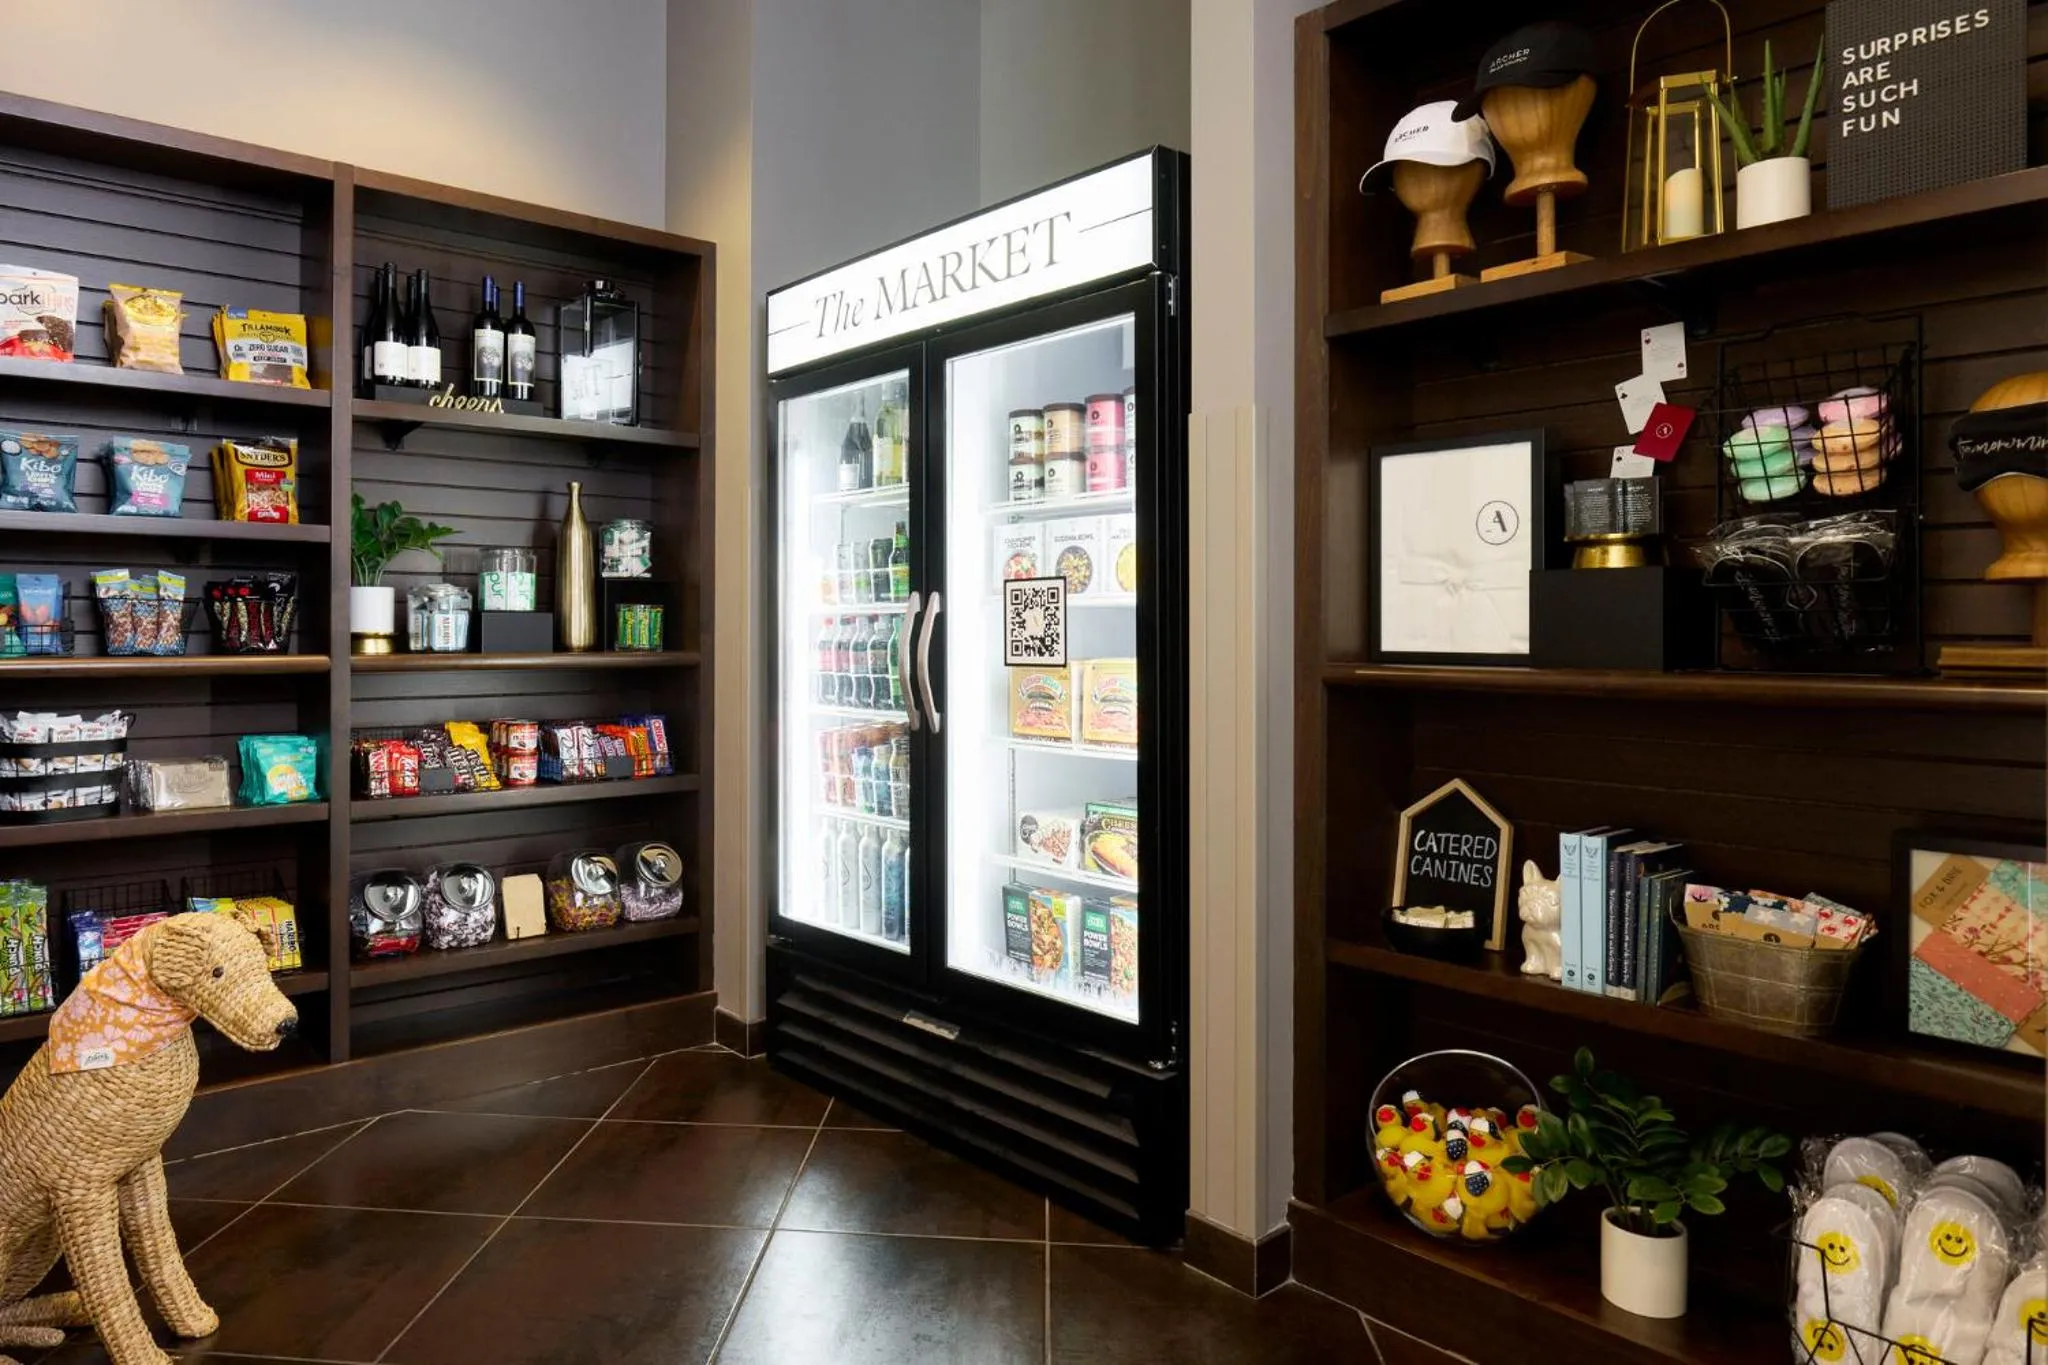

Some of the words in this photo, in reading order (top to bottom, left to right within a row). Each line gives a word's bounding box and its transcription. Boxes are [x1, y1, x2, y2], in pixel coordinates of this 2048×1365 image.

[1842, 8, 1990, 65] SURPRISES
[1489, 48, 1530, 68] ARCHER
[1842, 61, 1891, 90] ARE
[1842, 78, 1918, 113] SUCH
[1842, 107, 1901, 138] FUN
[813, 290, 865, 340] The
[873, 211, 1072, 321] MARKET
[20, 456, 62, 474] Kibo
[239, 450, 287, 462] SNYDER'S
[130, 464, 170, 484] Kibo
[1413, 828, 1498, 861] CATERED
[1410, 854, 1493, 888] CANINES
[285, 920, 297, 952] HARIBO
[8, 938, 20, 977] PUNCH
[32, 934, 45, 972] PUNCH
